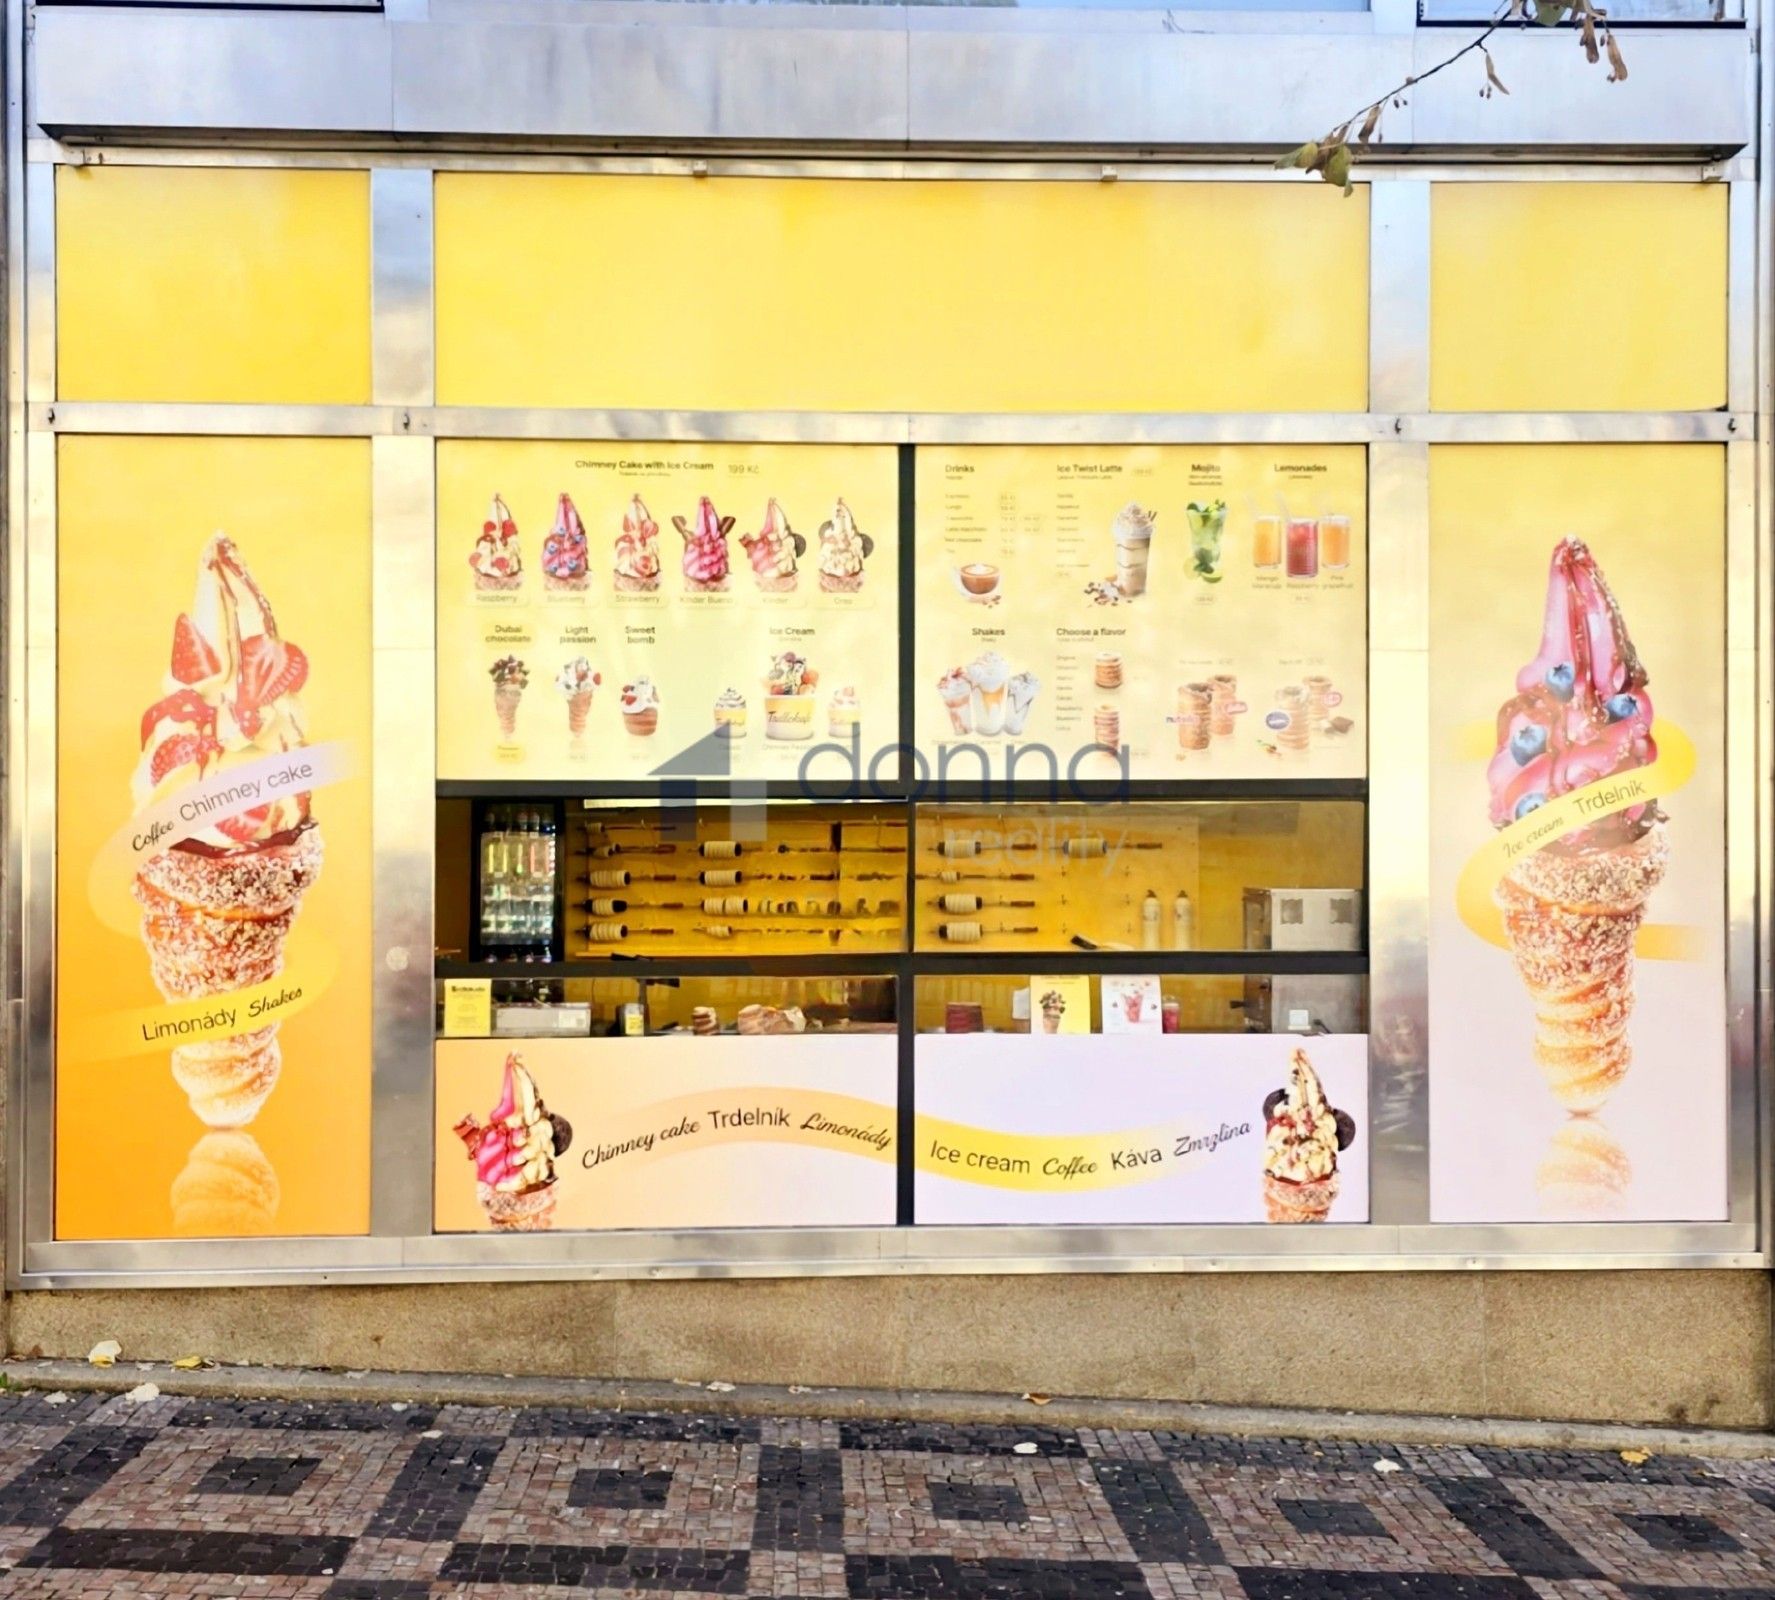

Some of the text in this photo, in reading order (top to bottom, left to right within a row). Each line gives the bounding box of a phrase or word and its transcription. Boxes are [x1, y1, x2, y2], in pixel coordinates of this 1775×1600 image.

[575, 460, 714, 470] Chimney Cake with Ice Cream
[945, 464, 975, 473] Drinks
[1056, 464, 1070, 472] Ice
[1072, 464, 1098, 472] Twist
[1099, 464, 1123, 472] Latte
[1191, 464, 1221, 473] Mojito
[1274, 464, 1328, 472] Lemonades
[476, 594, 518, 604] Raspberry
[616, 594, 660, 604] Strawberry
[680, 596, 706, 604] Kinder
[494, 624, 523, 634] Dubai
[565, 625, 589, 636] Light
[624, 626, 656, 634] Sweet
[768, 627, 816, 636] Ice Cream
[972, 628, 1006, 636] Shakes
[1056, 628, 1092, 636] Choose
[1100, 628, 1127, 636] flavor
[485, 635, 532, 643] chocolate
[560, 636, 597, 645] passion
[627, 636, 656, 644] bomb
[132, 763, 313, 851] Coffee Chimney cake
[1502, 842, 1523, 858] Ice
[1526, 816, 1564, 844] cream
[141, 986, 304, 1042] Limonády Shakes
[581, 1107, 892, 1170] Chimney cake Trdelník Limonády
[929, 1121, 1251, 1180] Ice cream Coffee Káva Zmrzlina
